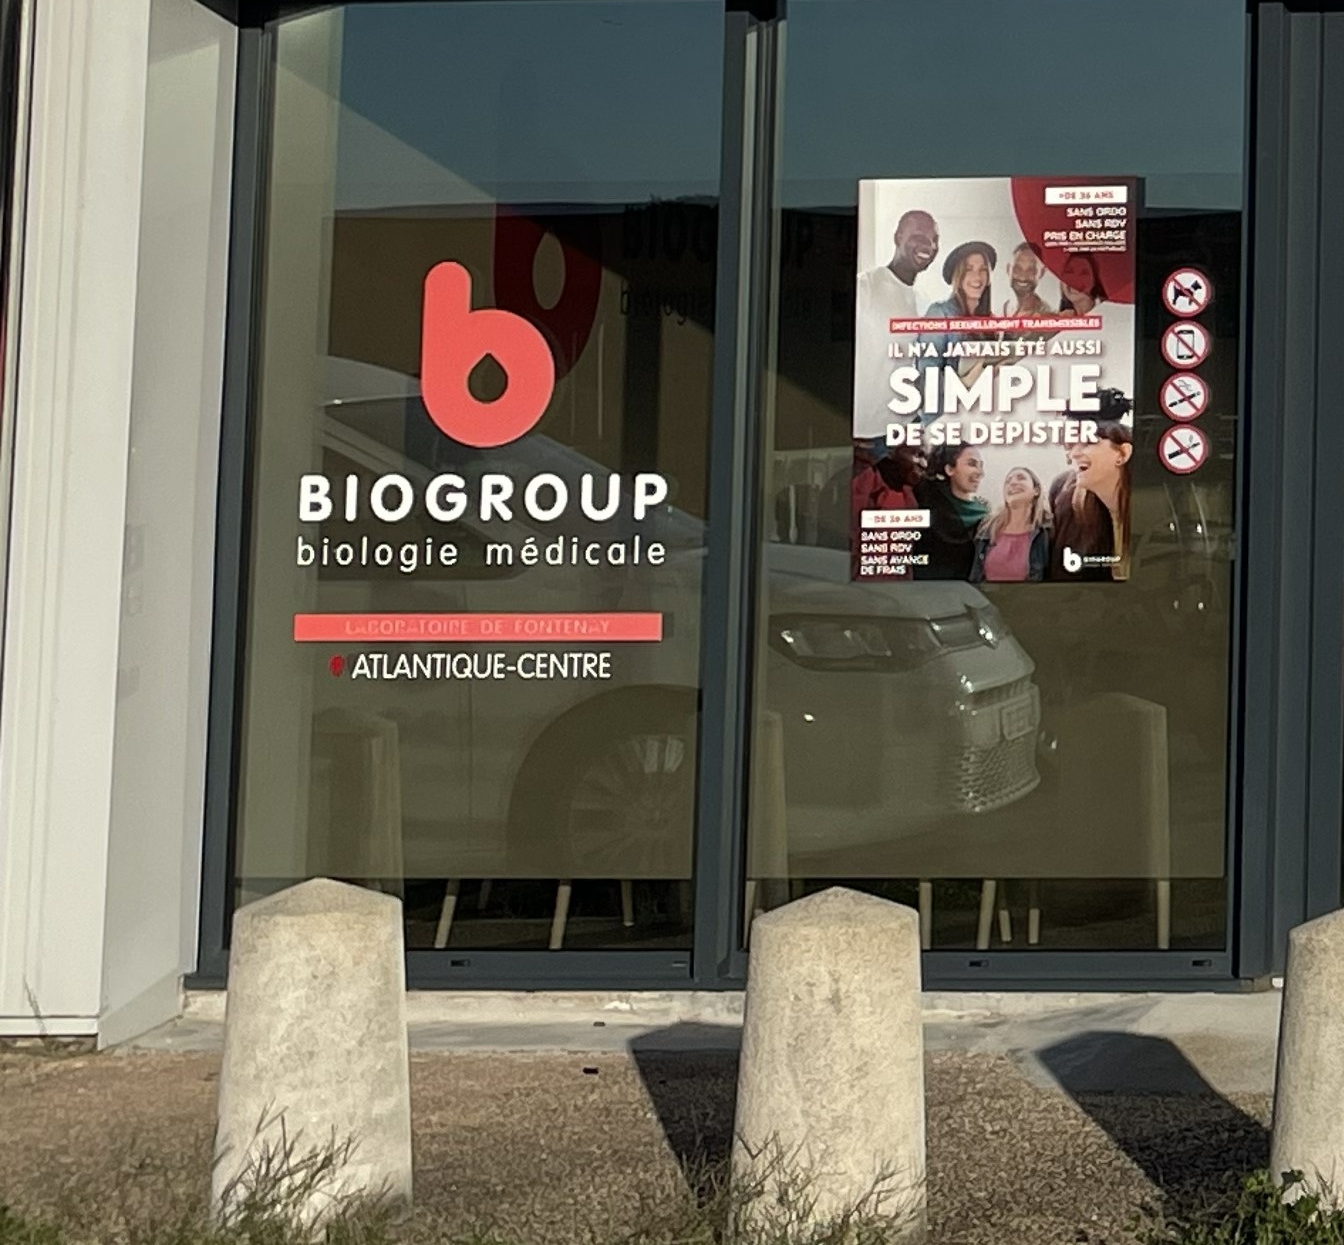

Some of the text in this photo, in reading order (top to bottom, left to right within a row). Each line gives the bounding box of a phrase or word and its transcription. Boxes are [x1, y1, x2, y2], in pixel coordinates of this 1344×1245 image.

[1066, 207, 1093, 217] SANS
[1075, 218, 1102, 228] SANS
[1043, 230, 1126, 241] PRIS EN CHARGE
[892, 318, 1100, 331] INFECTIONS SEXUELLEMENT TRANSMISSIBLES
[888, 337, 1101, 358] IL N'A JAMAIS ÉTÉ AUSSI
[887, 364, 1101, 414] SIMPLE
[886, 416, 1099, 446] DE SE DÉPISTER
[299, 473, 669, 522] BIOGROUP
[861, 531, 921, 541] SANS ORDO
[297, 535, 666, 573] biologie médicale
[861, 543, 912, 553] SANS RDV
[861, 554, 929, 565] SANS AVANCE
[861, 565, 906, 575] DE FRAIS
[345, 618, 610, 635] LABORATOIRE DE FONTENAY
[351, 652, 612, 679] ATLANTIQUE-CENTRE
